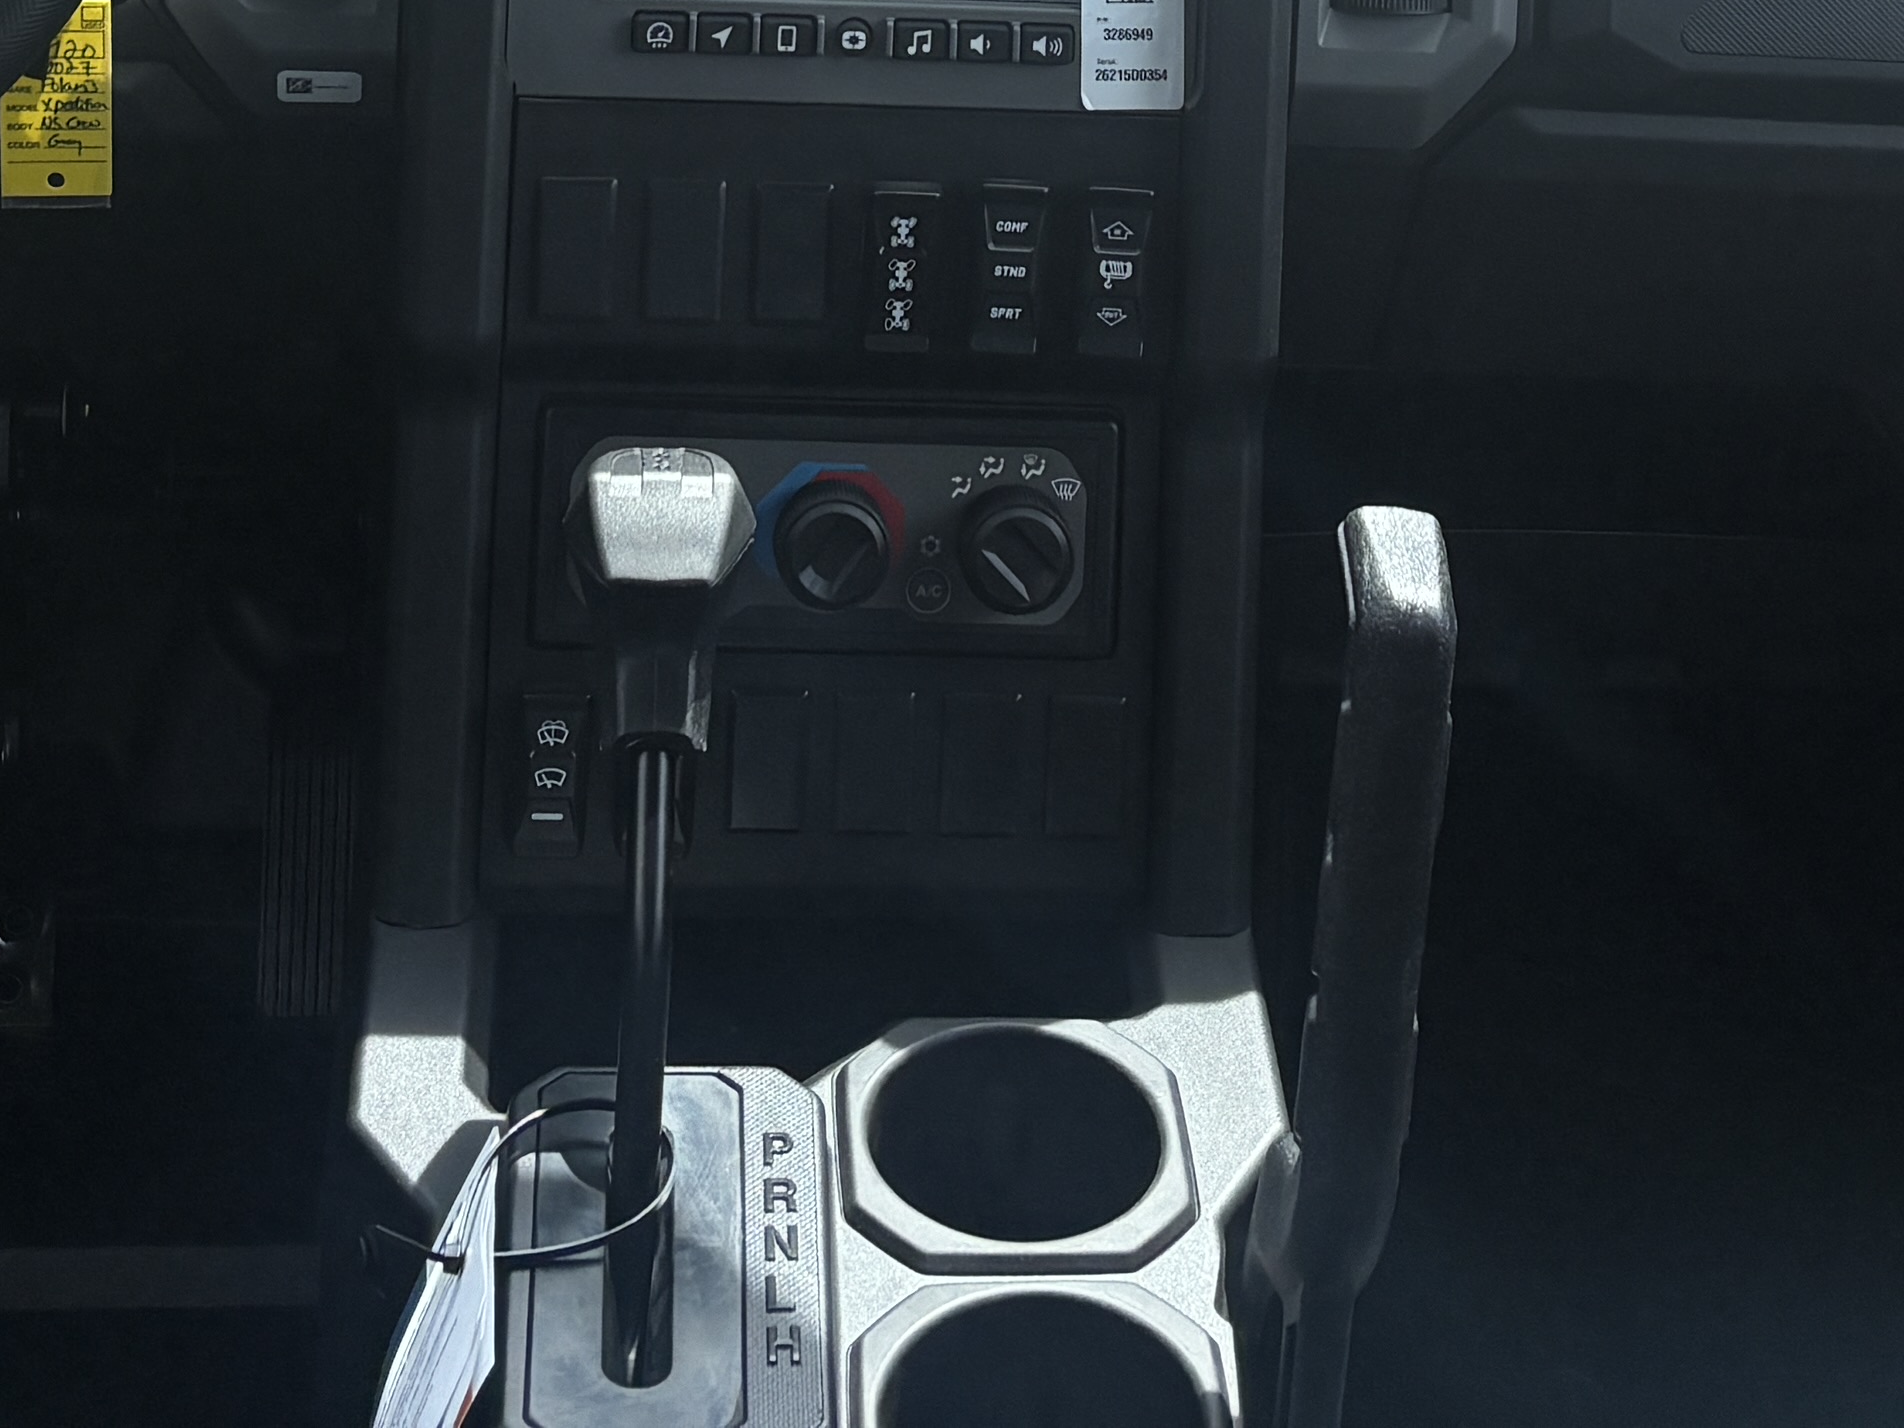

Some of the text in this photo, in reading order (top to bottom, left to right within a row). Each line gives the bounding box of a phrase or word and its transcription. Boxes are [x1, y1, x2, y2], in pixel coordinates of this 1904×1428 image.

[996, 221, 1028, 233] COMF
[994, 265, 1026, 278] STND
[990, 307, 1022, 320] SPRT
[763, 1132, 793, 1166] P
[763, 1178, 798, 1214] R
[764, 1225, 798, 1261] N
[765, 1276, 796, 1313] L
[767, 1325, 801, 1366] H
